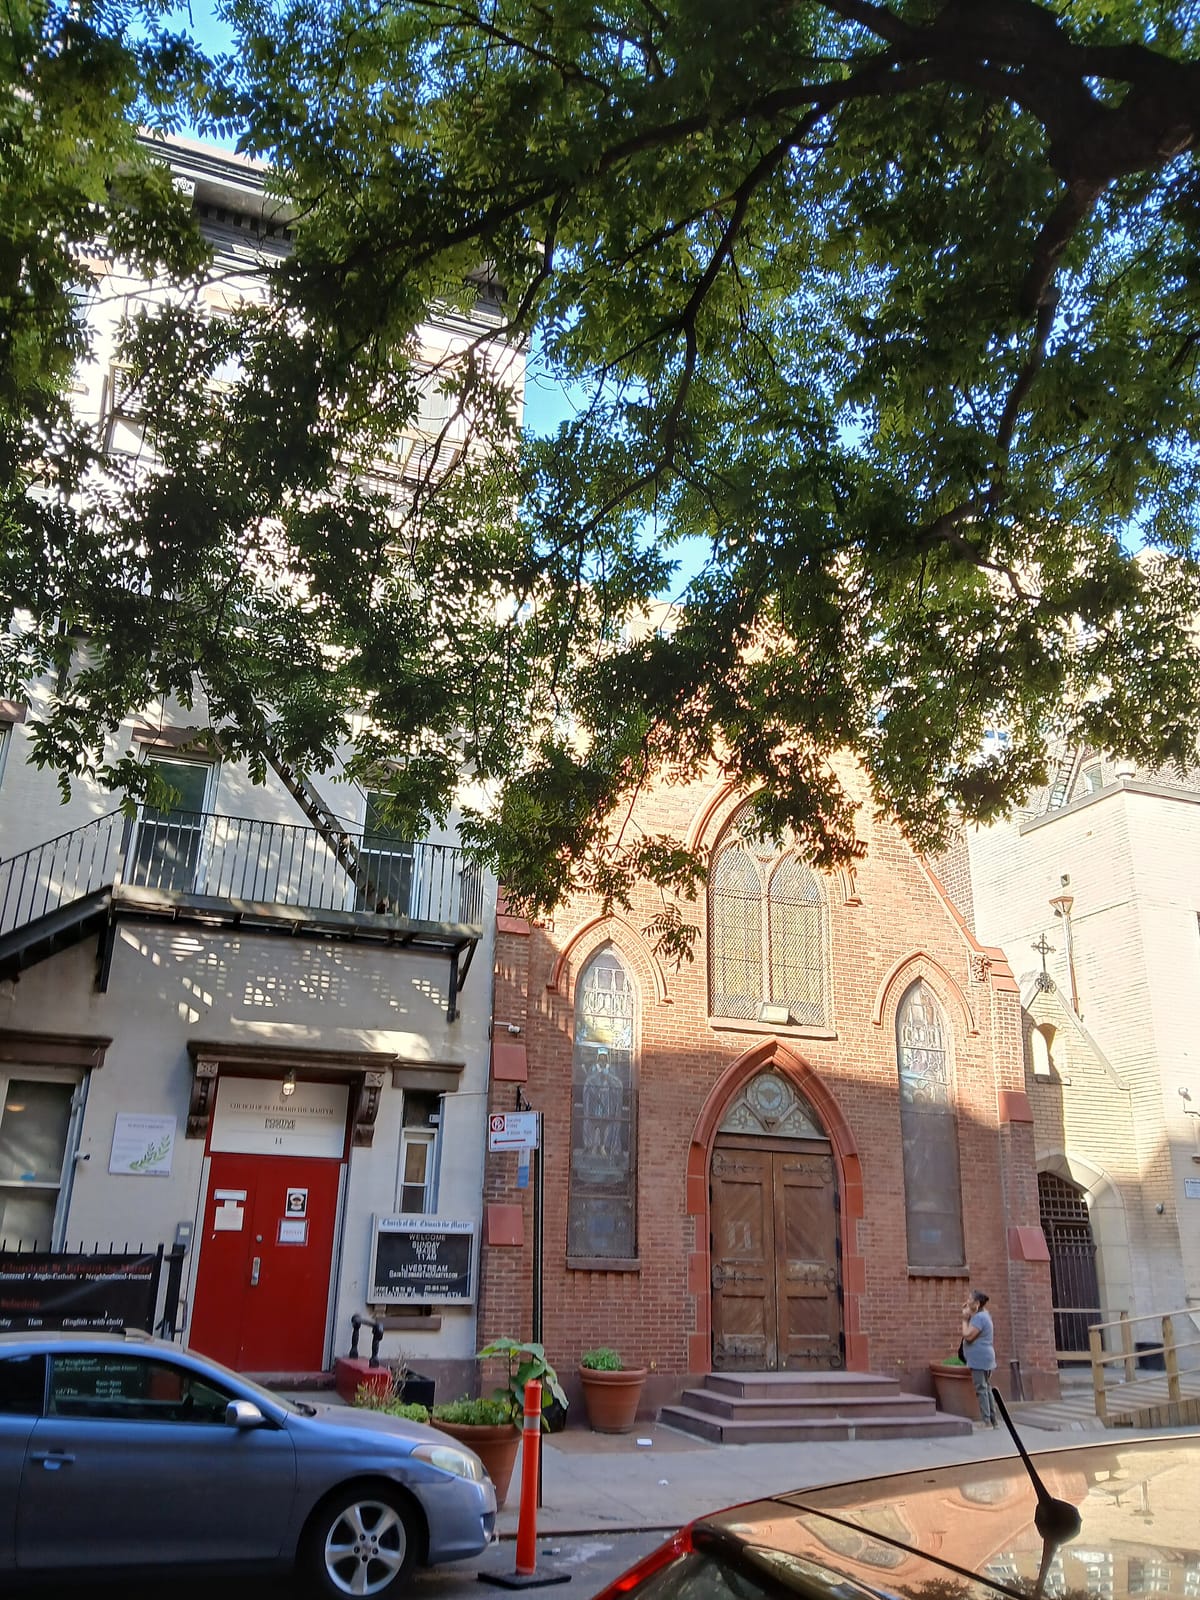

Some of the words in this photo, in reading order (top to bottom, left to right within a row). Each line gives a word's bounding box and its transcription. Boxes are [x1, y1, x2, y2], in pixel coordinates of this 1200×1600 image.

[409, 1233, 446, 1241] WELCOME
[411, 1241, 441, 1249] SUNDAY
[415, 1247, 438, 1255] MASS
[401, 1264, 449, 1272] LIVESTREAM
